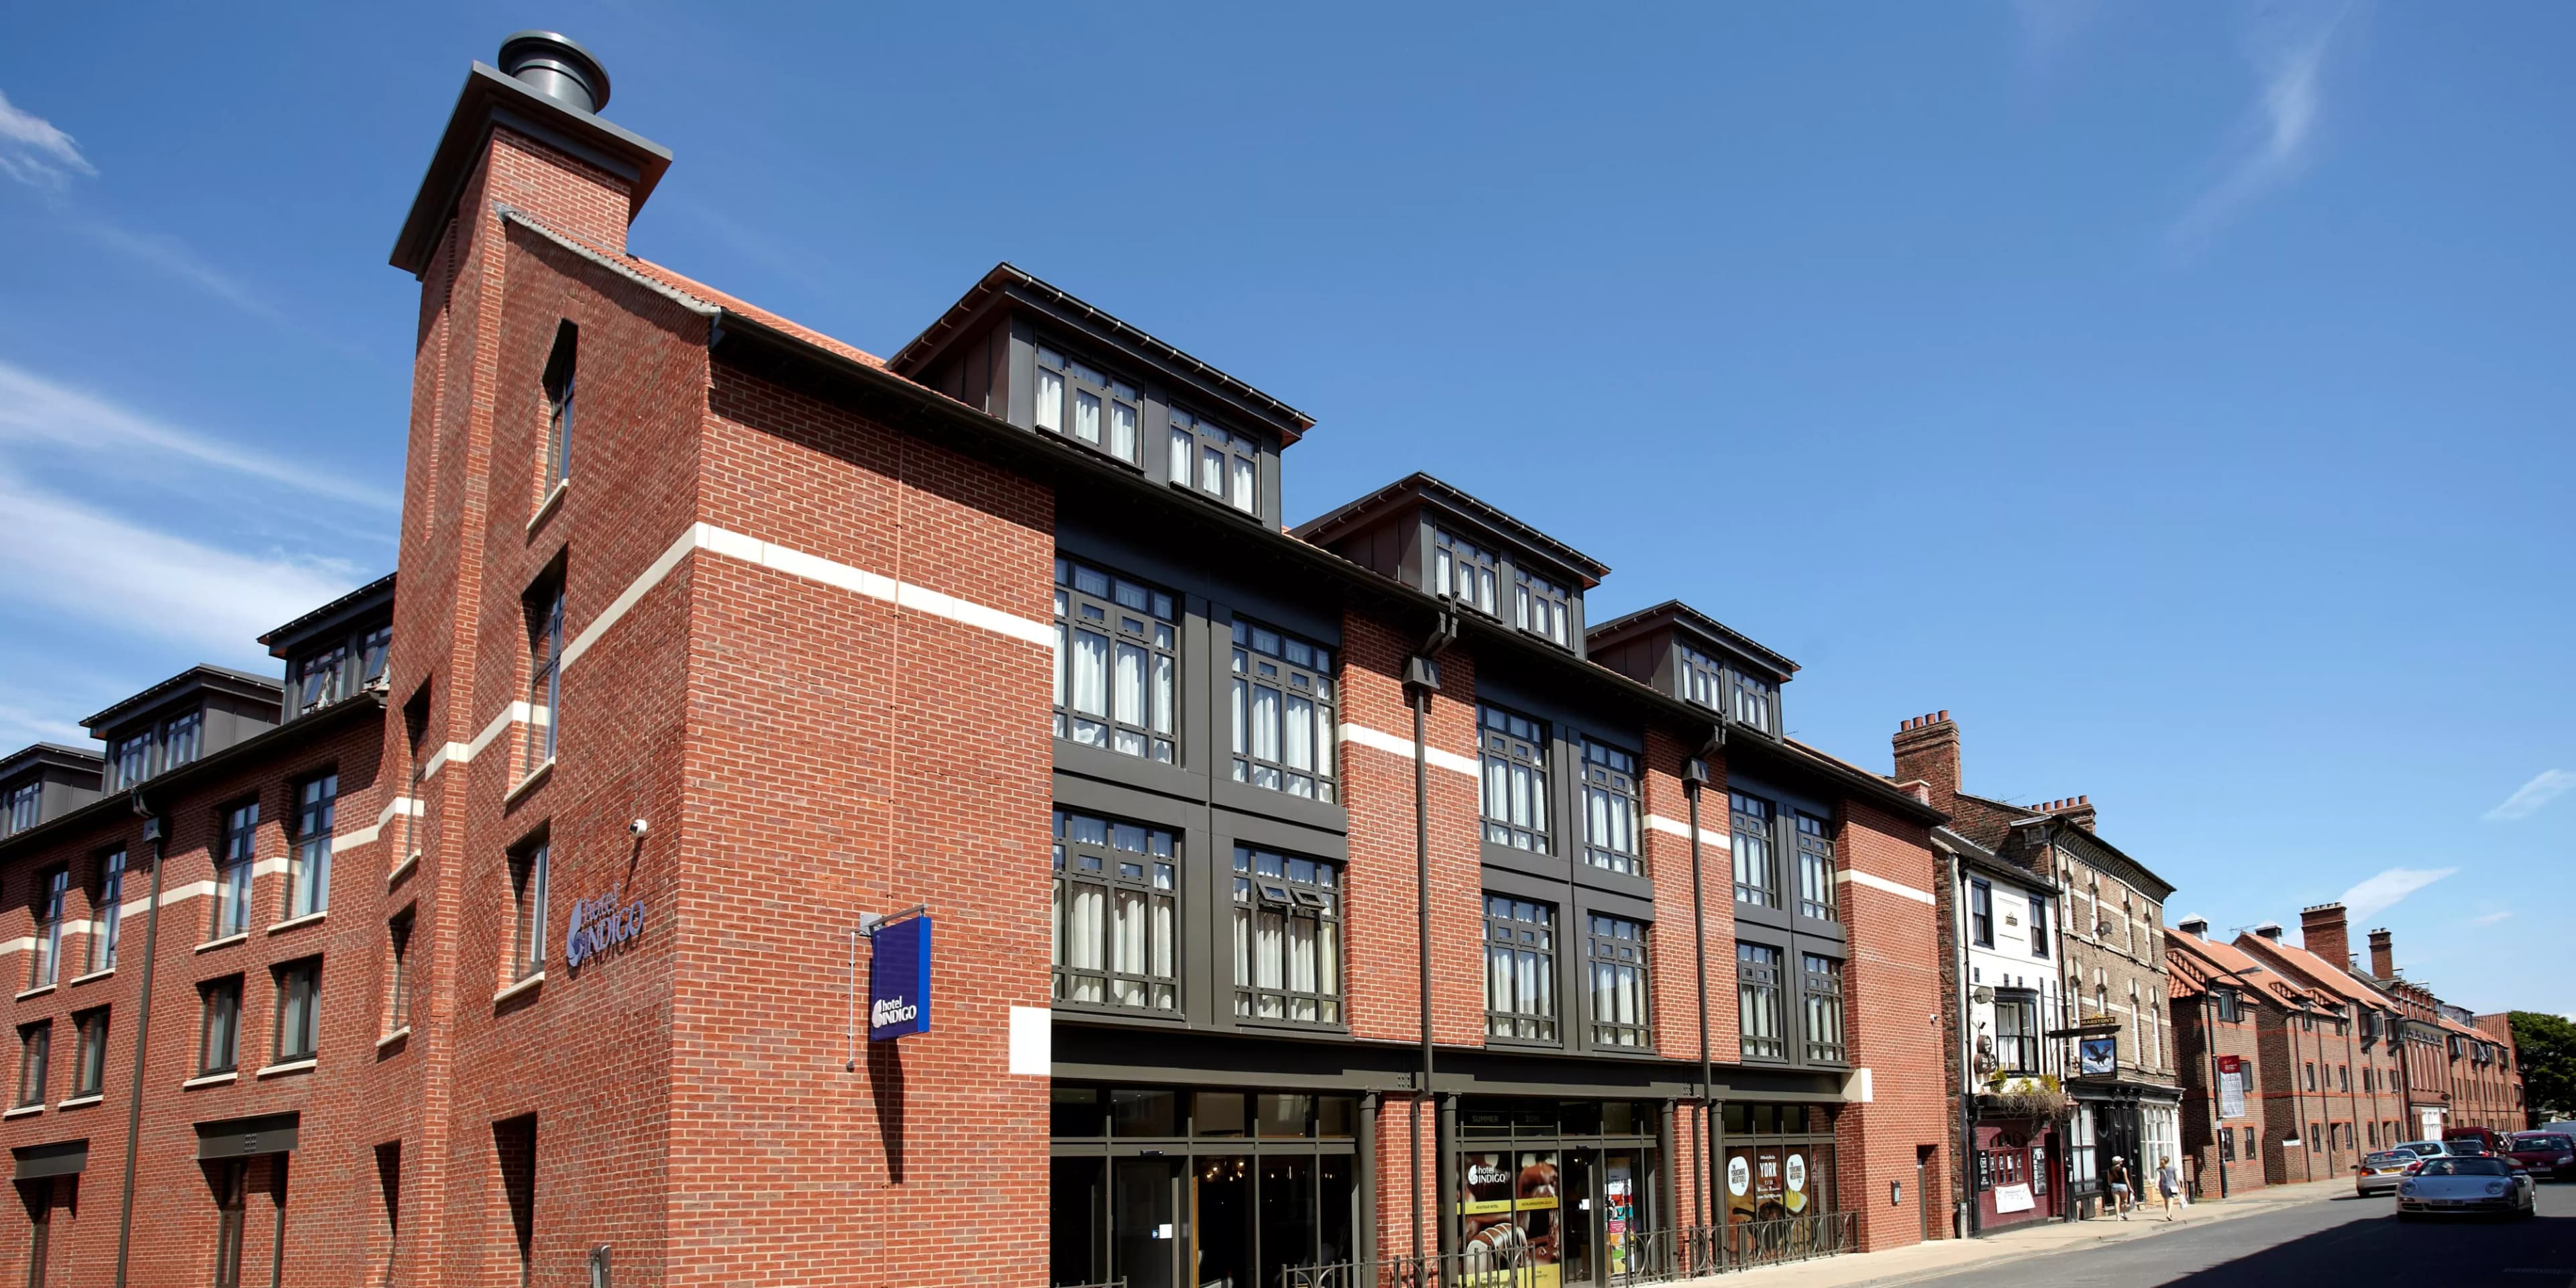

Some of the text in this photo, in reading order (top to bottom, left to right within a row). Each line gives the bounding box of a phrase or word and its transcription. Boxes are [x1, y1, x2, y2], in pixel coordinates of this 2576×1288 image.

[584, 881, 619, 923] hotel
[582, 900, 645, 959] INDIGO
[882, 996, 902, 1012] hotel
[882, 1005, 917, 1026] INDIGO
[1478, 1166, 1494, 1174] hotel
[1759, 1162, 1777, 1178] YORK
[1479, 1174, 1506, 1184] INDIGO
